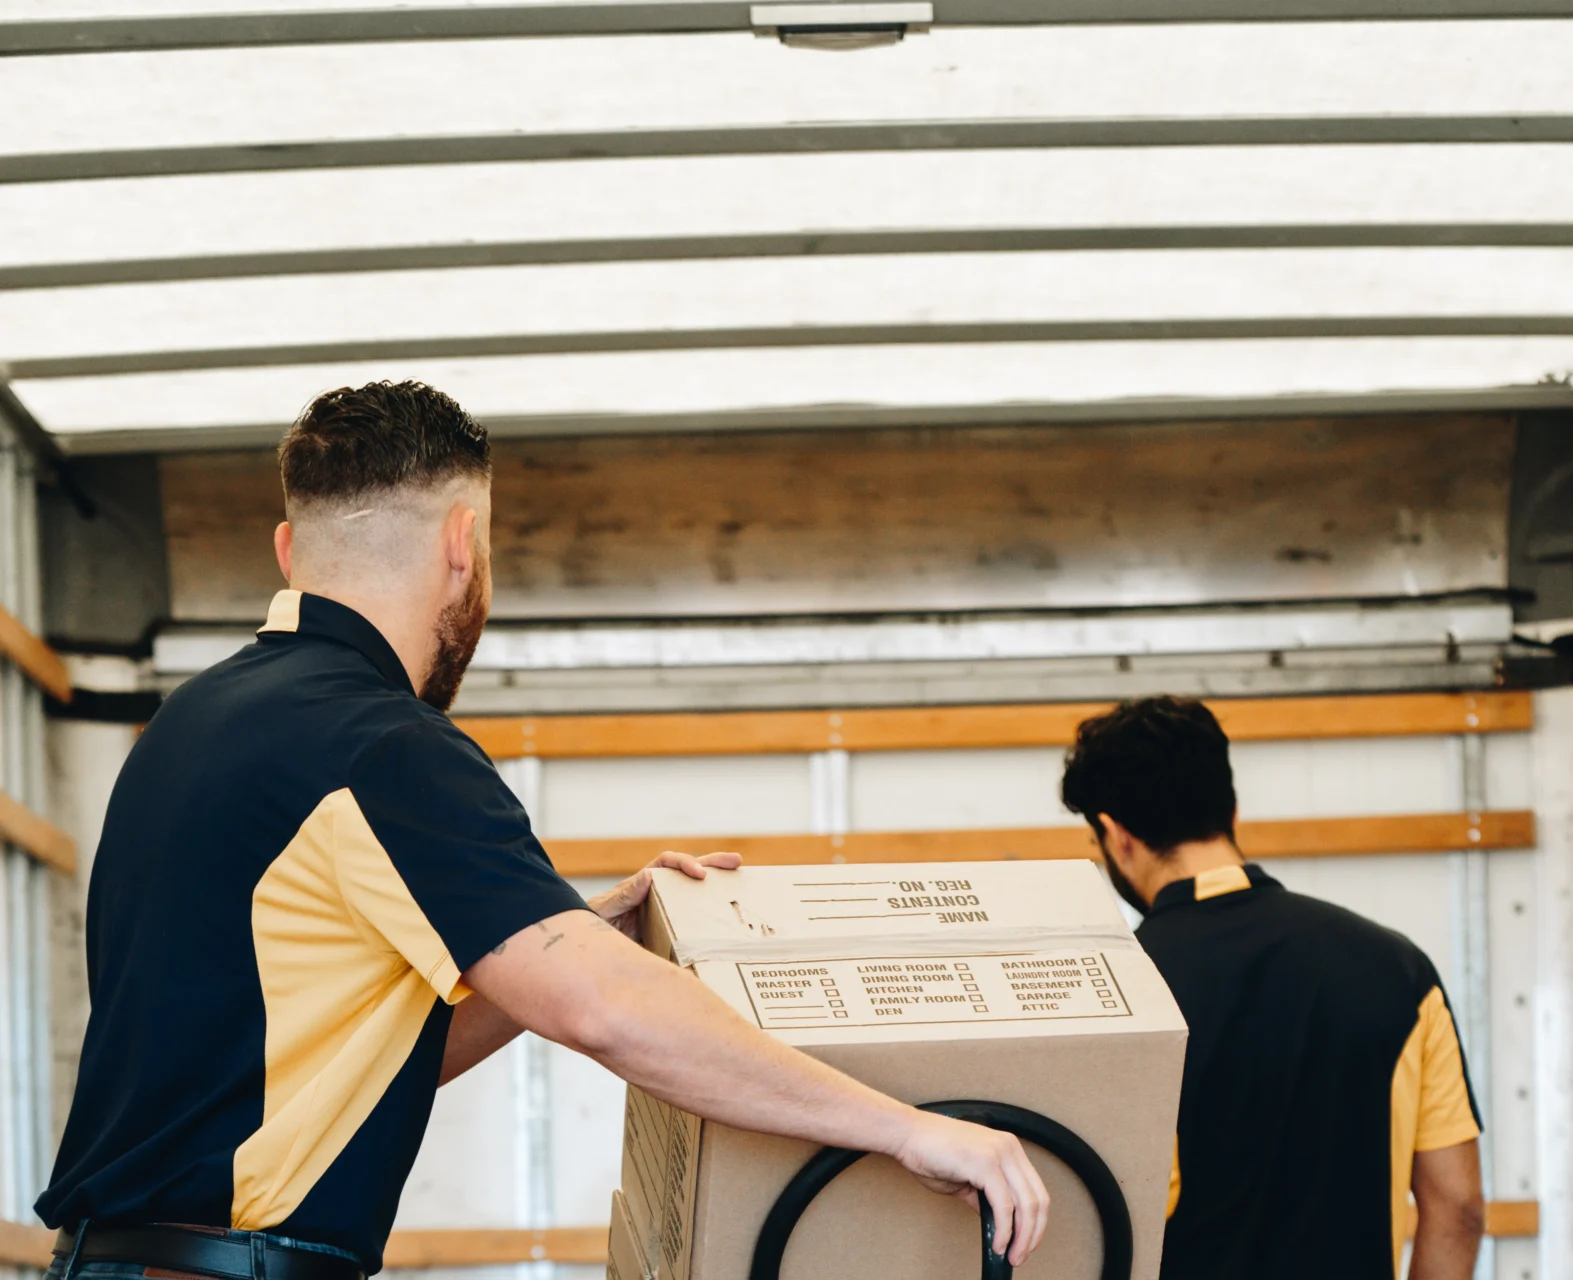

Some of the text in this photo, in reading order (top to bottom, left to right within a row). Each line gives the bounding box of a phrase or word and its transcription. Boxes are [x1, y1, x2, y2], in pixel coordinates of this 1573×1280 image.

[892, 879, 972, 893] REG. NO.
[887, 895, 980, 909] CONTENTS
[936, 911, 990, 923] NAME
[856, 963, 947, 973] LIVING ROOM
[1001, 958, 1078, 969] BATHROOM
[751, 968, 829, 978] BEDROOMS
[1005, 969, 1082, 980] LAUNDRY ROOM
[861, 974, 954, 984] DINING ROOM
[755, 980, 812, 989] MASTER
[1010, 980, 1083, 990] BASEMENT
[760, 990, 804, 999] GUEST
[865, 985, 924, 995] KITCHEN
[870, 995, 966, 1005] FAMILY ROOM
[1016, 992, 1072, 1001] GARAGE
[875, 1007, 903, 1016] DEN
[1021, 1002, 1060, 1011] ATTIC
